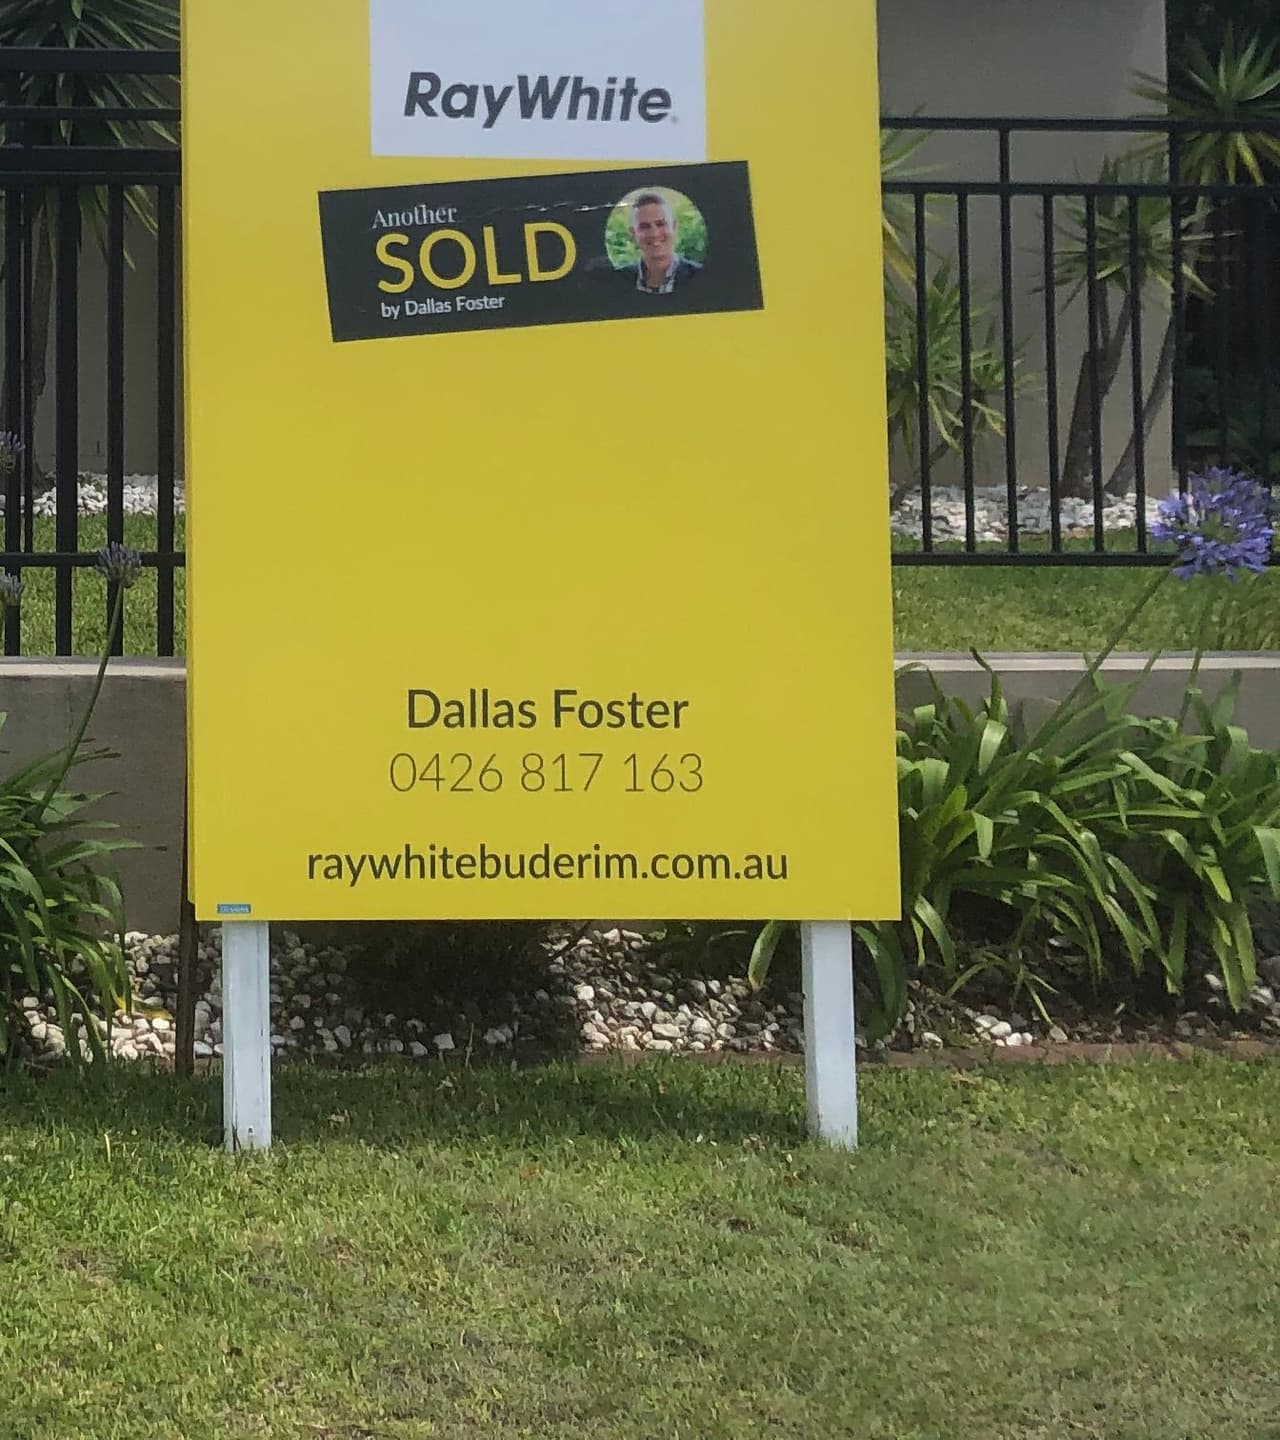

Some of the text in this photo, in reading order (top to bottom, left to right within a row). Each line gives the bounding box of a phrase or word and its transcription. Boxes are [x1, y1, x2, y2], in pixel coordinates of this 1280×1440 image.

[371, 203, 458, 229] Another
[375, 221, 577, 293] SOLD
[381, 295, 505, 319] by Dallas Foster
[407, 688, 689, 729] Dallas Foster
[389, 753, 704, 793] 0426 817 163
[307, 844, 788, 887] raywhitebuderim.com.au
